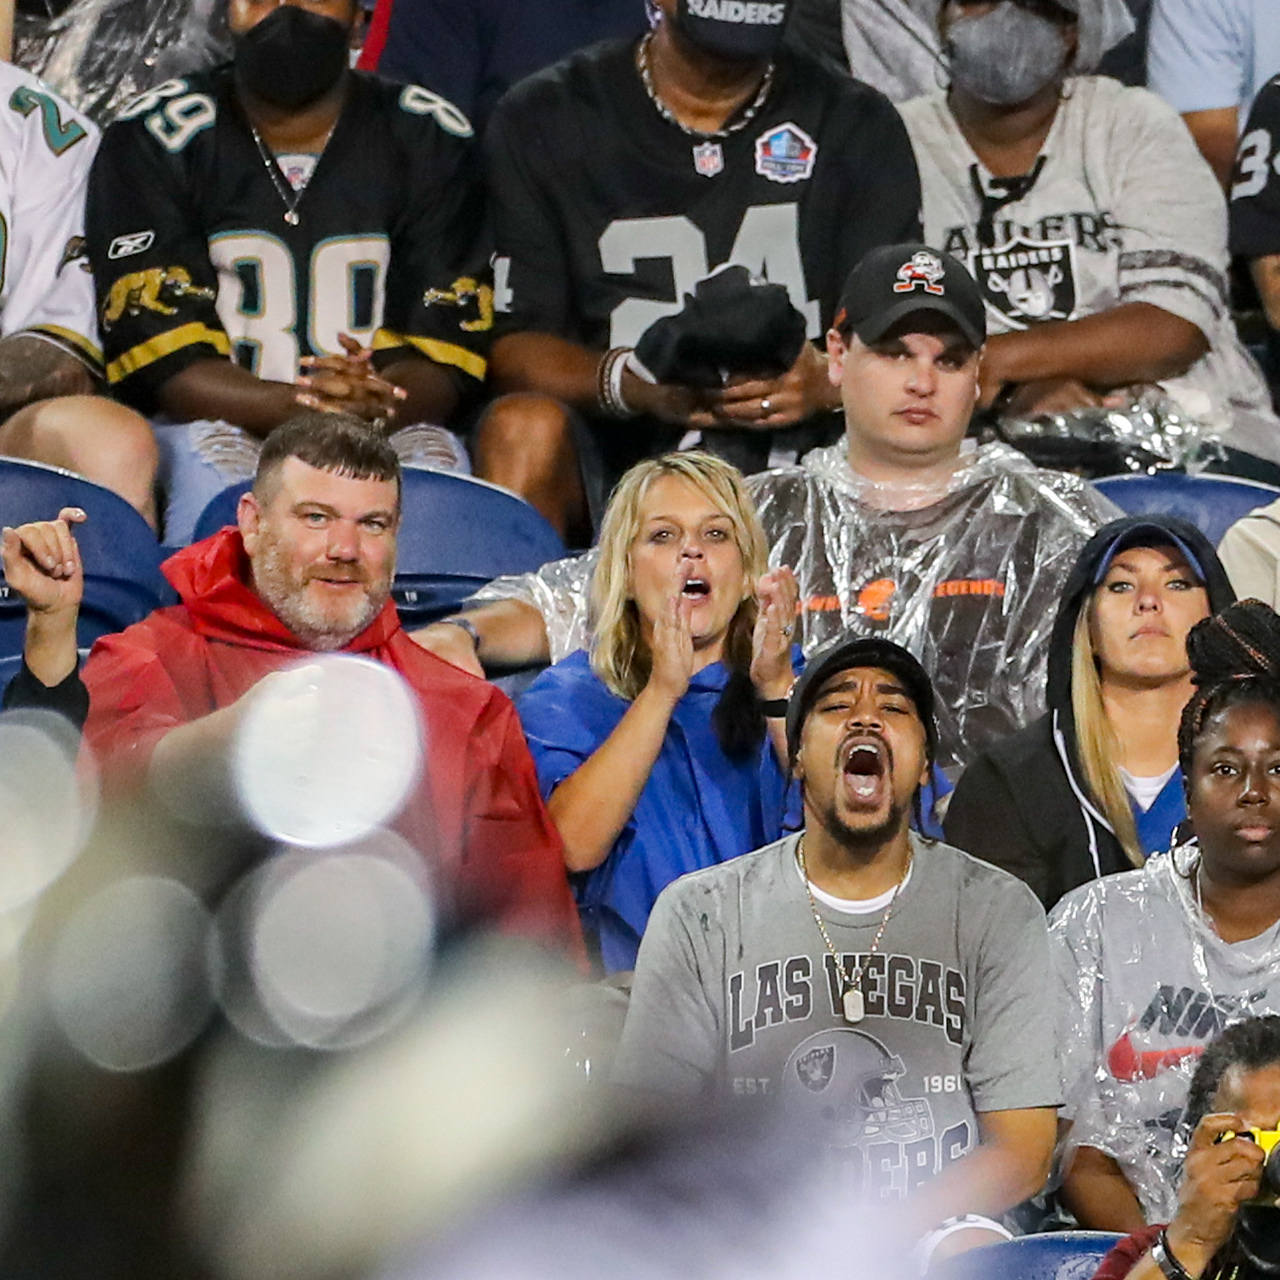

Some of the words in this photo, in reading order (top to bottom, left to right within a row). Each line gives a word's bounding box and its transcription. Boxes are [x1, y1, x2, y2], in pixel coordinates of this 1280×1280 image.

[687, 0, 785, 25] RAIDERS
[598, 202, 820, 350] 24
[982, 247, 1063, 271] RAIDERS
[728, 954, 814, 1054] LAS
[822, 952, 967, 1048] VEGAS
